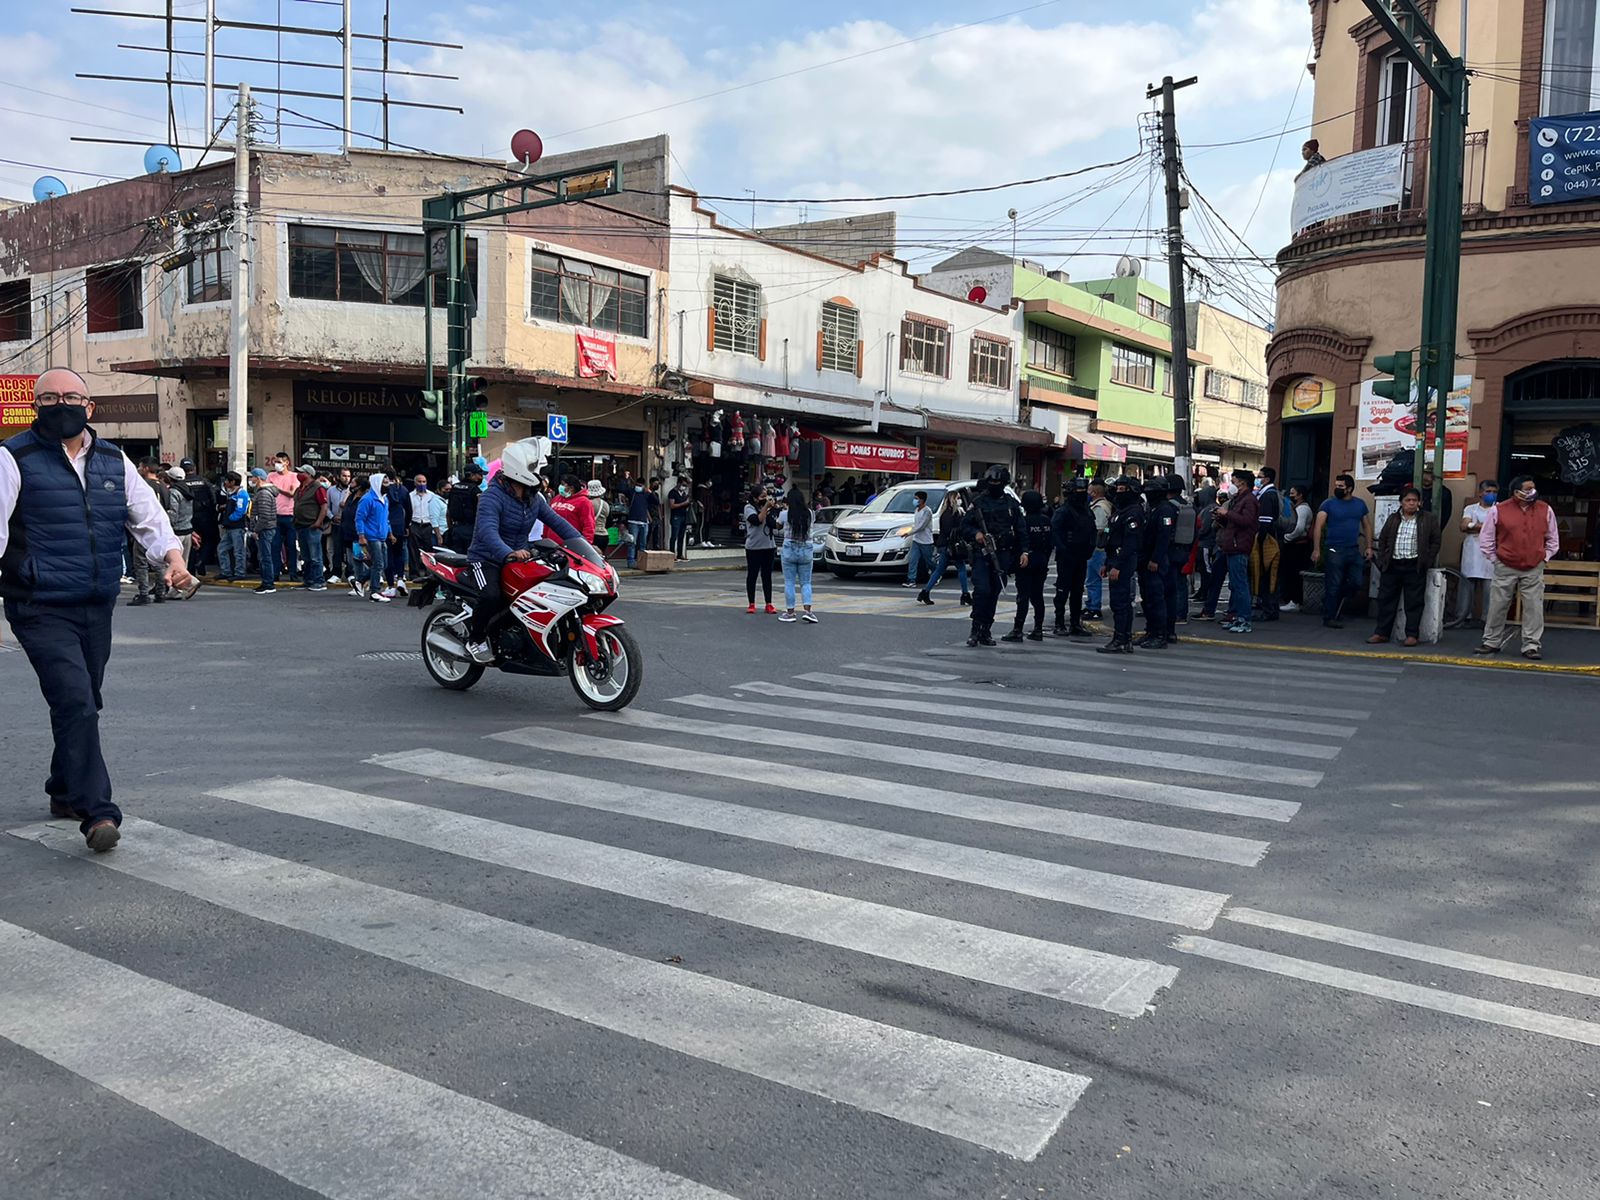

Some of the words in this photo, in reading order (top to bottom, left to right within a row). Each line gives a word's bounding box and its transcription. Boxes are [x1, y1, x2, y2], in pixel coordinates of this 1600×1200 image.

[1564, 125, 1600, 144] (72
[1564, 180, 1588, 191] (044)
[1370, 405, 1394, 416] Rappi
[849, 444, 871, 457] DONAS
[872, 446, 878, 457] Y
[878, 447, 905, 459] CHURROS
